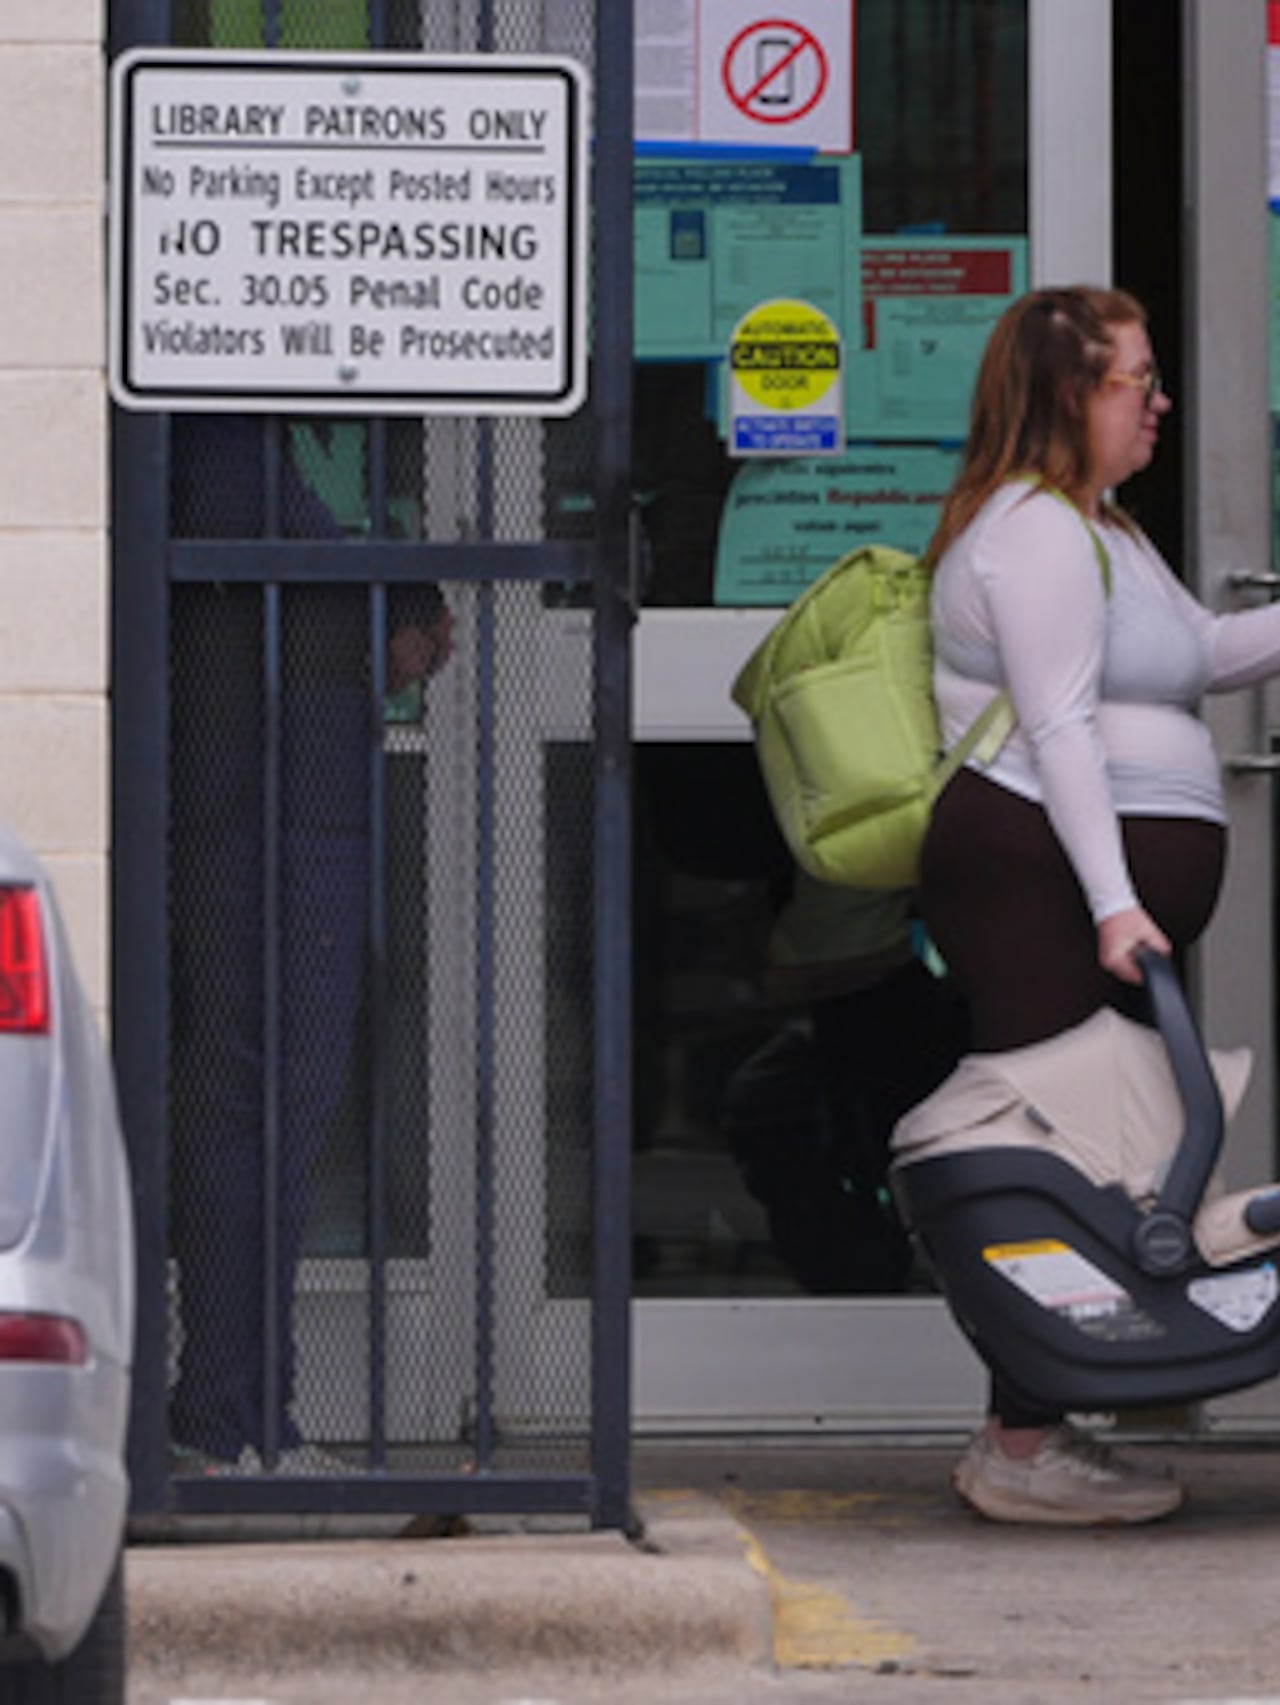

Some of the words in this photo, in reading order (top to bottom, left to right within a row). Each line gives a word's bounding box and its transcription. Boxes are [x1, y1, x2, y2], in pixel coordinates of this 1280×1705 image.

[153, 105, 284, 135] LIBRARY
[306, 107, 445, 138] PATRONS
[469, 110, 547, 140] ONLY
[143, 167, 174, 195] No
[190, 165, 280, 206] Parking
[296, 168, 373, 206] Except
[391, 170, 471, 200] Posted
[485, 172, 556, 203] Hours
[252, 221, 537, 260] TRESPASSING
[154, 273, 220, 306] Sec.
[242, 275, 328, 307] 30.05
[350, 277, 440, 308] Penal
[462, 278, 543, 310] Code
[143, 322, 264, 355] Violators
[281, 323, 332, 355] Will
[350, 326, 384, 356] Be
[401, 327, 555, 359] Prosecuted
[734, 343, 838, 368] CAUTION
[761, 373, 809, 391] DOOR
